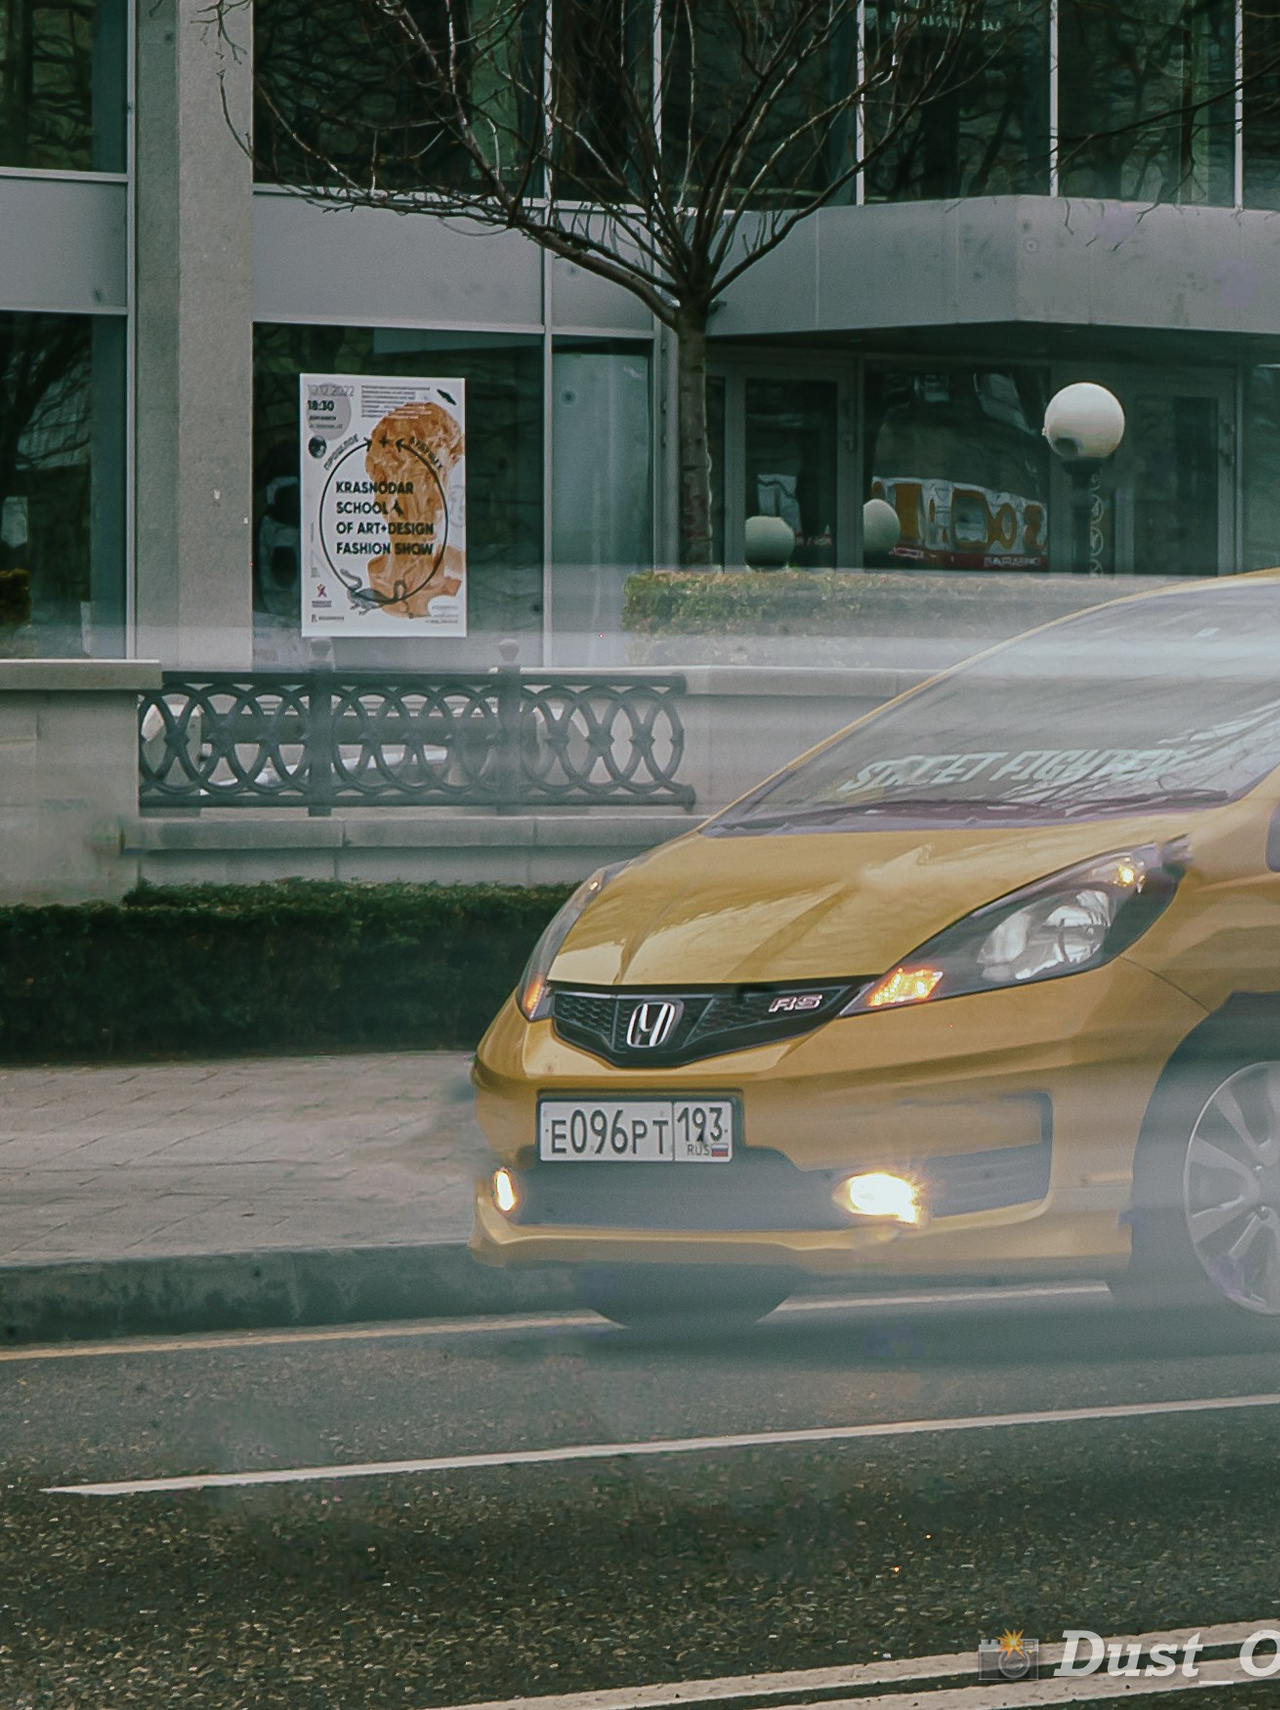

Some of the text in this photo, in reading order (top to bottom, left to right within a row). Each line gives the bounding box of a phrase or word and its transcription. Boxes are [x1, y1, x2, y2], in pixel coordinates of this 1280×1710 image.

[307, 400, 335, 412] 18:30
[336, 481, 414, 495] KRASNODAR
[336, 501, 388, 515] SCHOOL
[336, 522, 354, 535] OF
[336, 543, 434, 556] FASHION SHOW
[768, 994, 823, 1013] RS
[676, 1106, 724, 1142] 193
[686, 1143, 710, 1157] RUS
